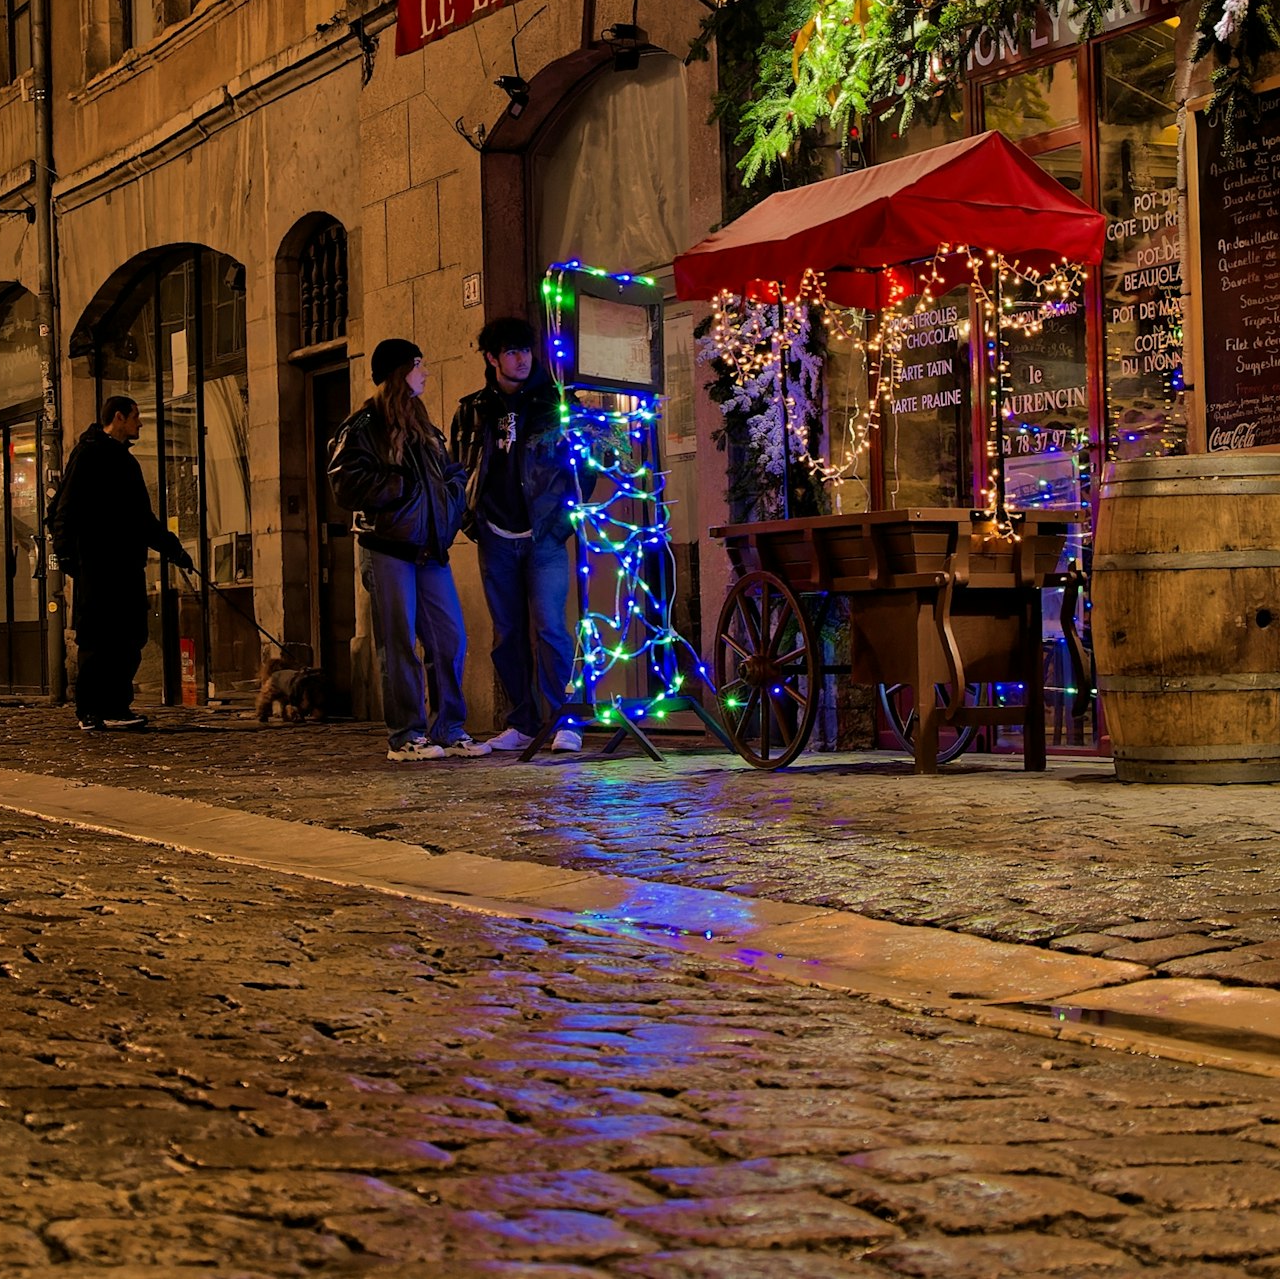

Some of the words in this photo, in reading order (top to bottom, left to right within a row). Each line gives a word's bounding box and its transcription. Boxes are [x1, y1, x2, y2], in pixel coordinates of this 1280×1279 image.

[1220, 140, 1259, 157] lade
[1133, 191, 1158, 214] POT
[1163, 187, 1177, 204] DE
[1245, 191, 1256, 201] de
[1106, 218, 1137, 242] COTE
[1142, 213, 1160, 233] DU
[1137, 246, 1160, 268] POT
[1165, 242, 1180, 262] DE
[1218, 249, 1261, 273] Quenelle
[1265, 249, 1277, 260] de
[1113, 305, 1136, 325] POT
[1140, 300, 1156, 320] DE
[906, 325, 960, 350] CHOCOLAT
[1225, 337, 1250, 352] Filet
[926, 358, 953, 378] TATIN
[1028, 365, 1043, 385] le
[1122, 358, 1139, 376] DU
[890, 396, 918, 415] TARTE
[921, 389, 962, 411] PRALINE
[1016, 434, 1030, 454] 78
[1034, 432, 1048, 452] 37
[1052, 429, 1067, 449] 97
